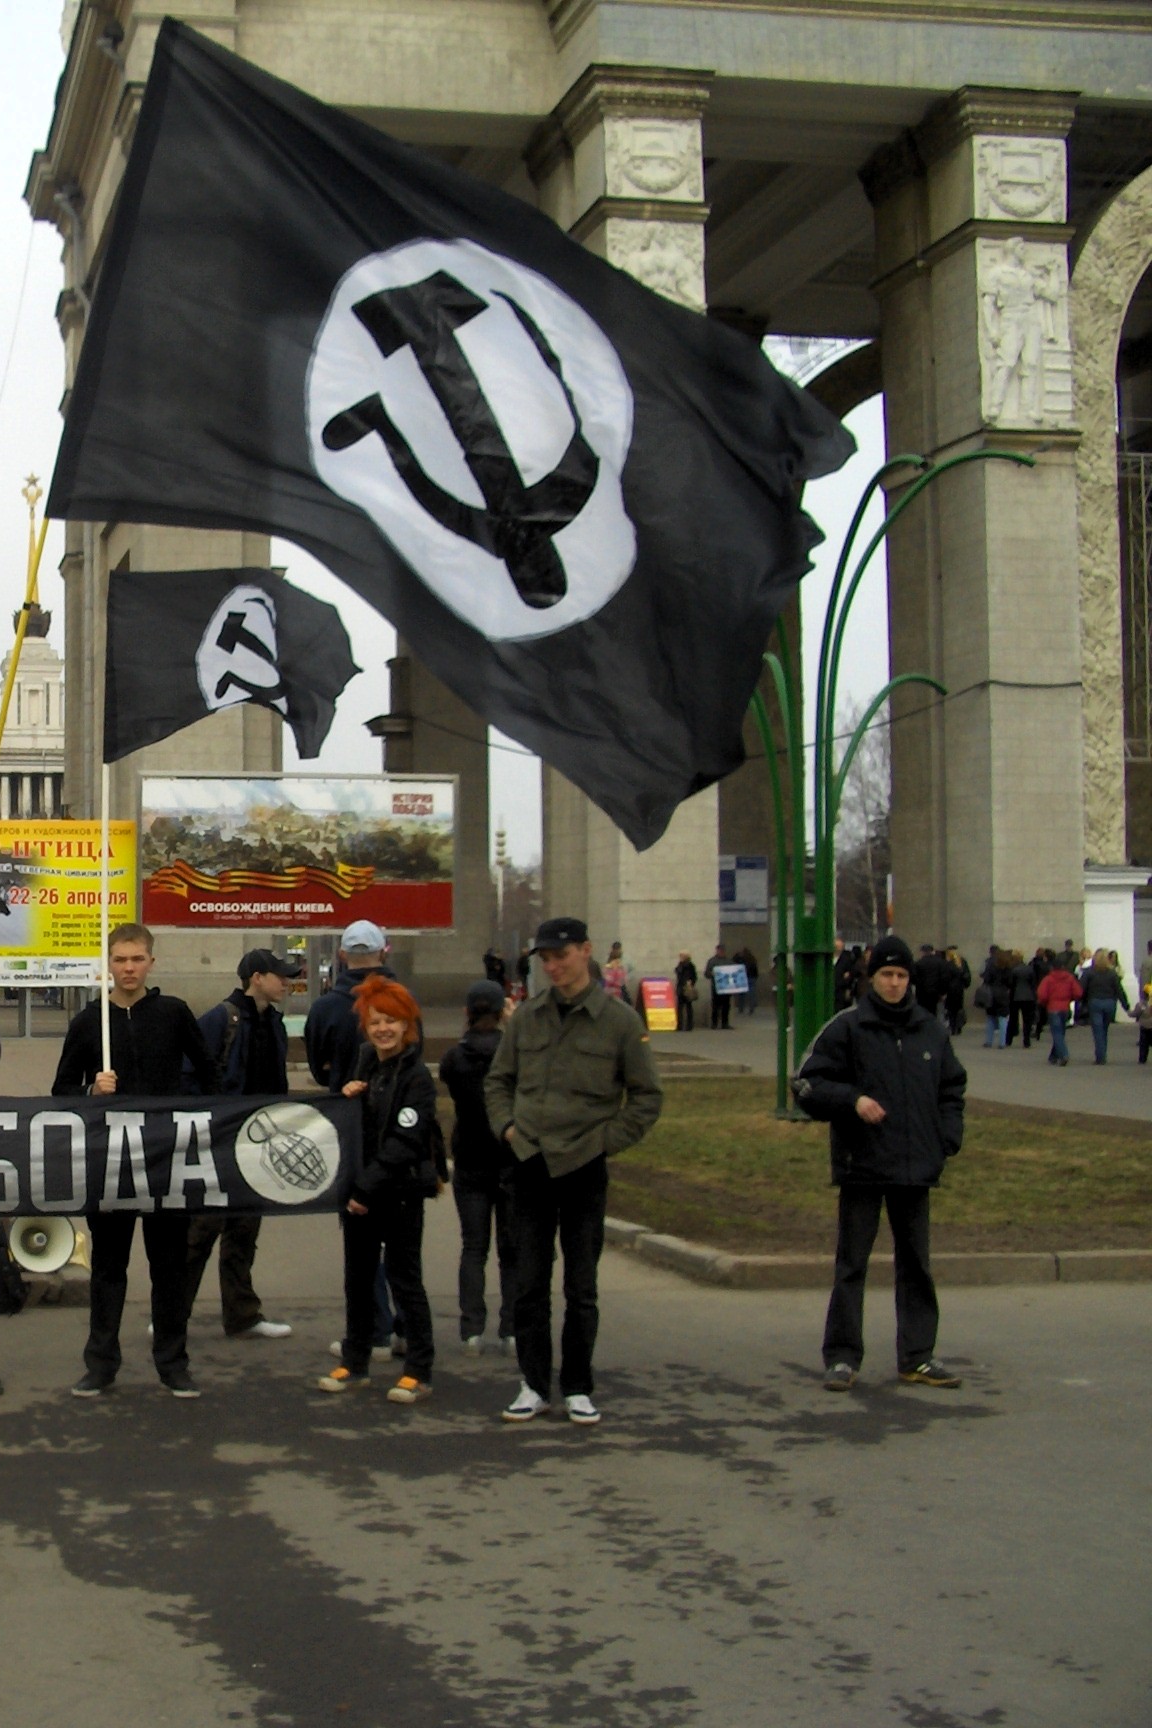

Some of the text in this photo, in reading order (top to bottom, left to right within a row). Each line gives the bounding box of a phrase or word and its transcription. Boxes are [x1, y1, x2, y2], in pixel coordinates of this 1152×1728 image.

[10, 887, 59, 905] 22-26
[189, 902, 334, 914] ОСВОБОЖДЕНИЕ КИЕВА
